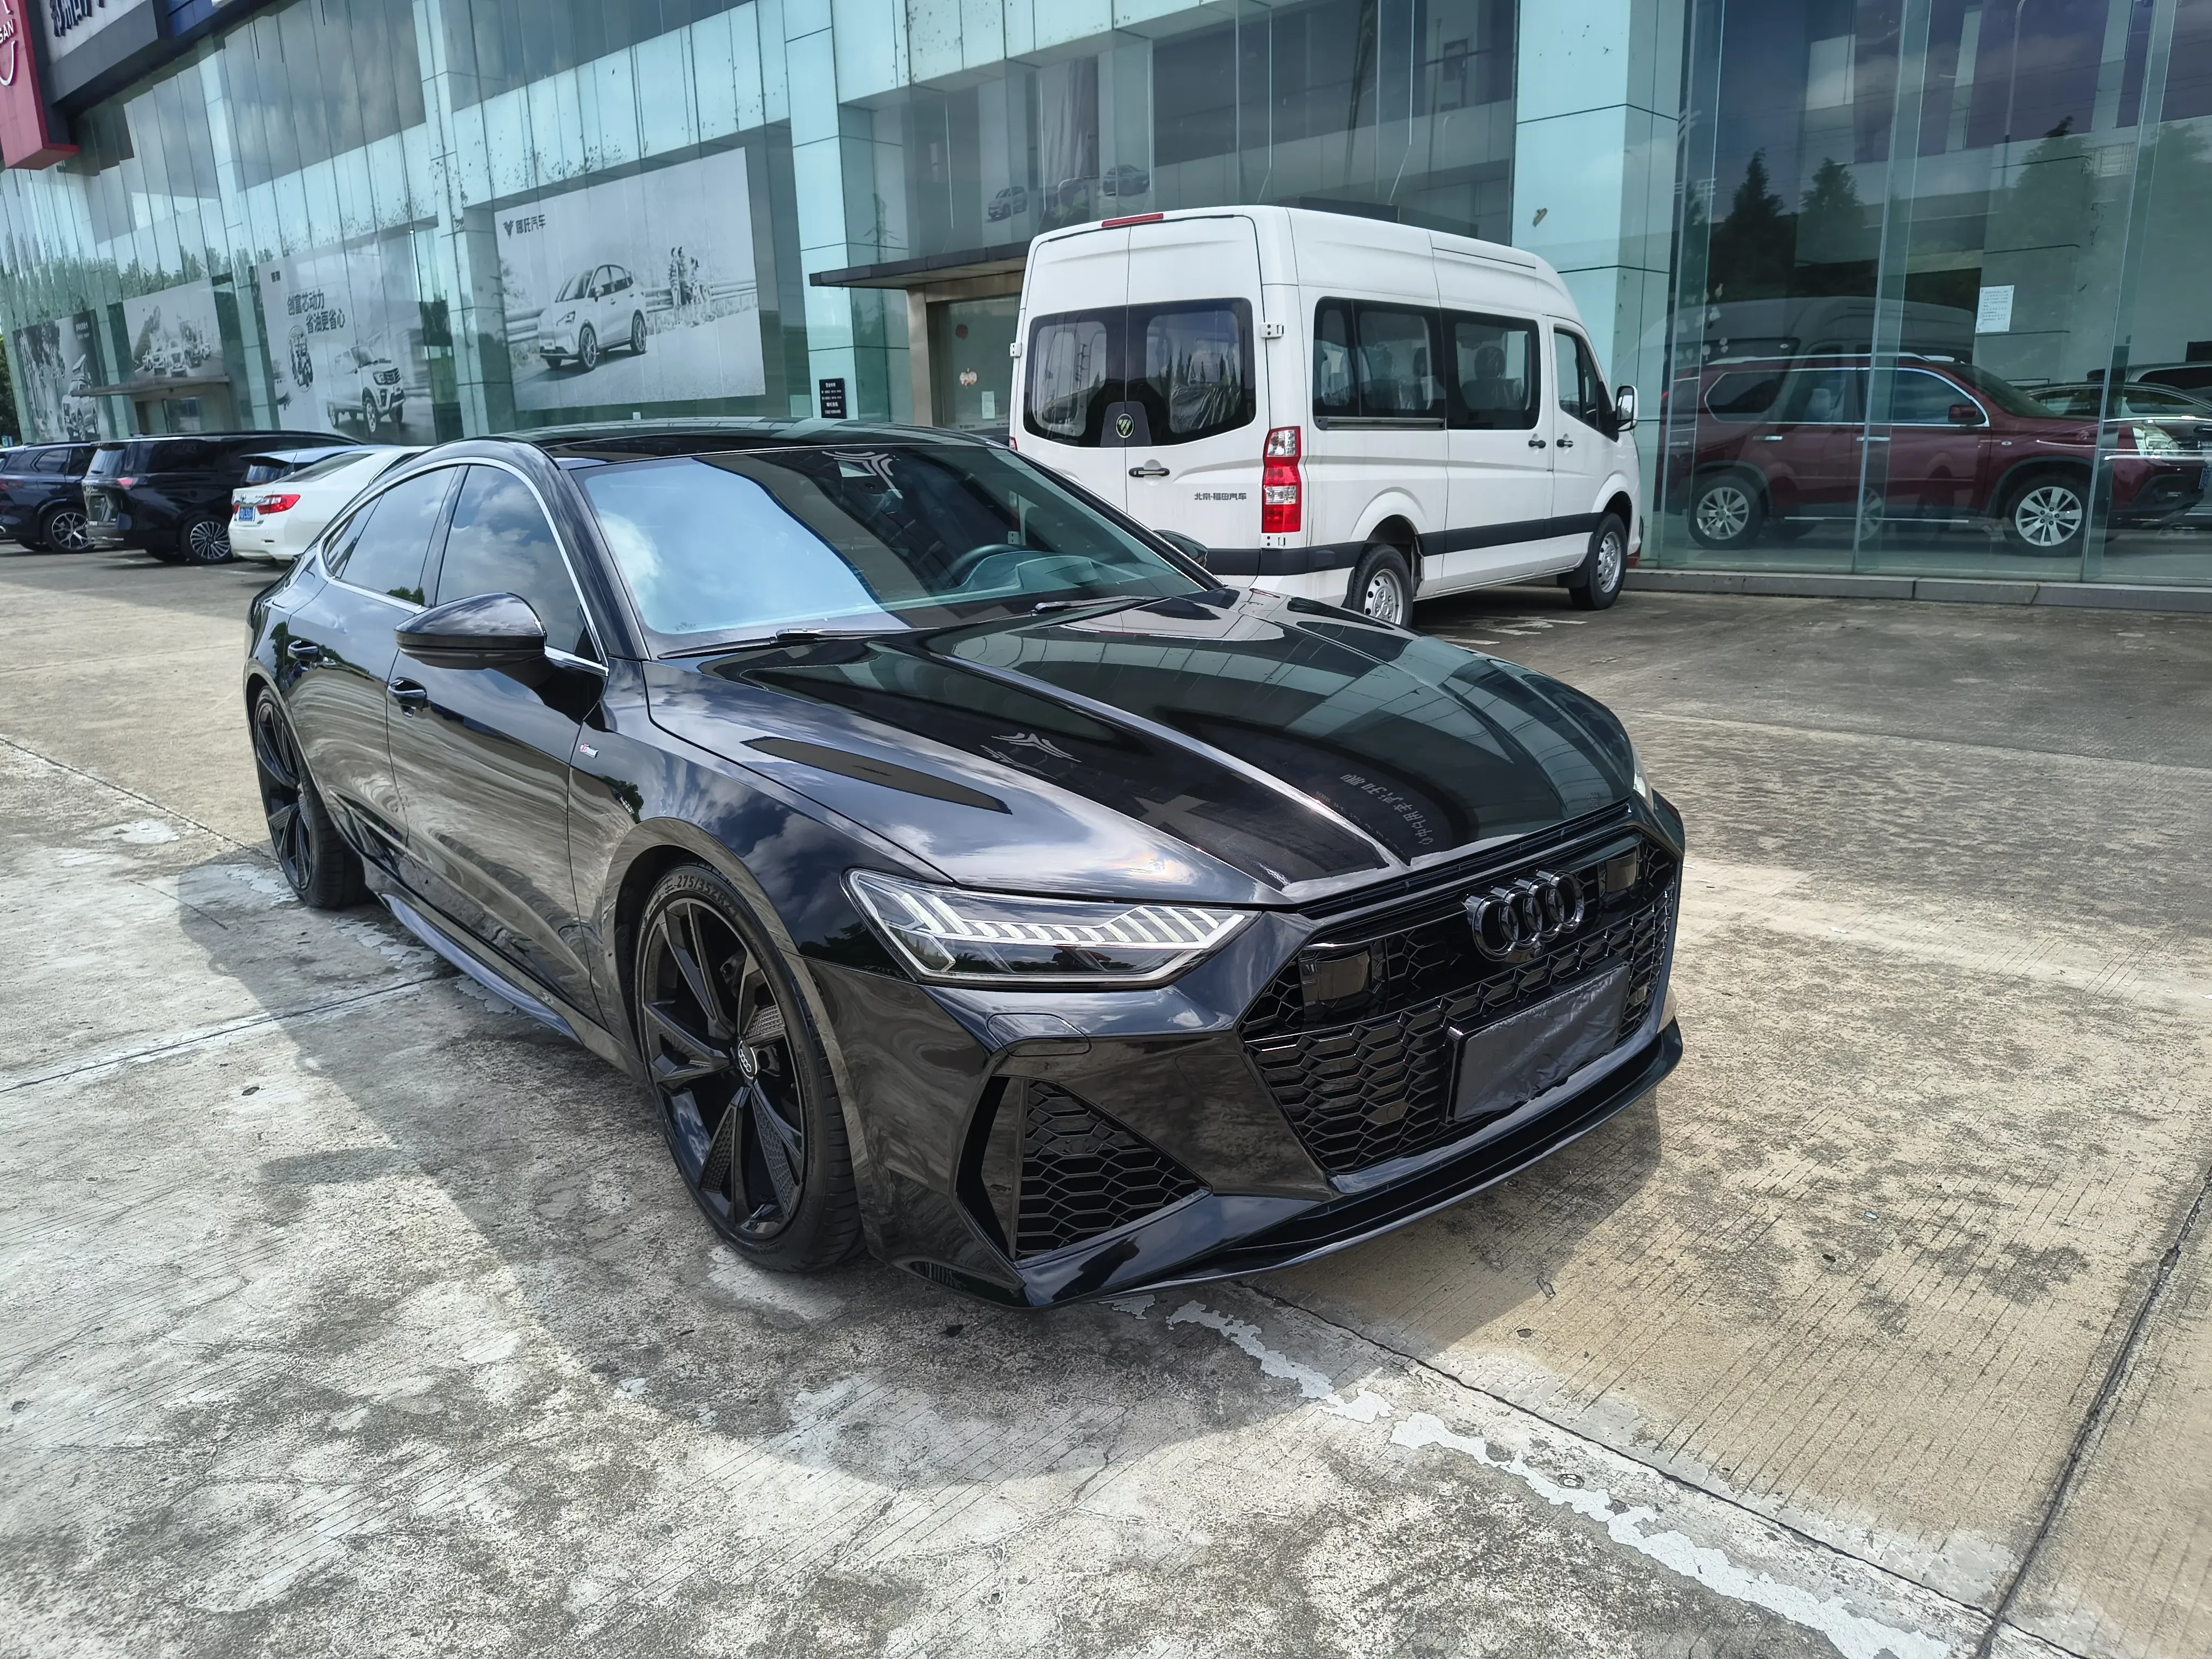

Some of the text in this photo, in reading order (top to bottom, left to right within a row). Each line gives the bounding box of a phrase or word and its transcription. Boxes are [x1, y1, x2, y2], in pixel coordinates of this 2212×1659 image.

[287, 288, 324, 315] 创富芯动力
[306, 308, 346, 334] 省油更省心
